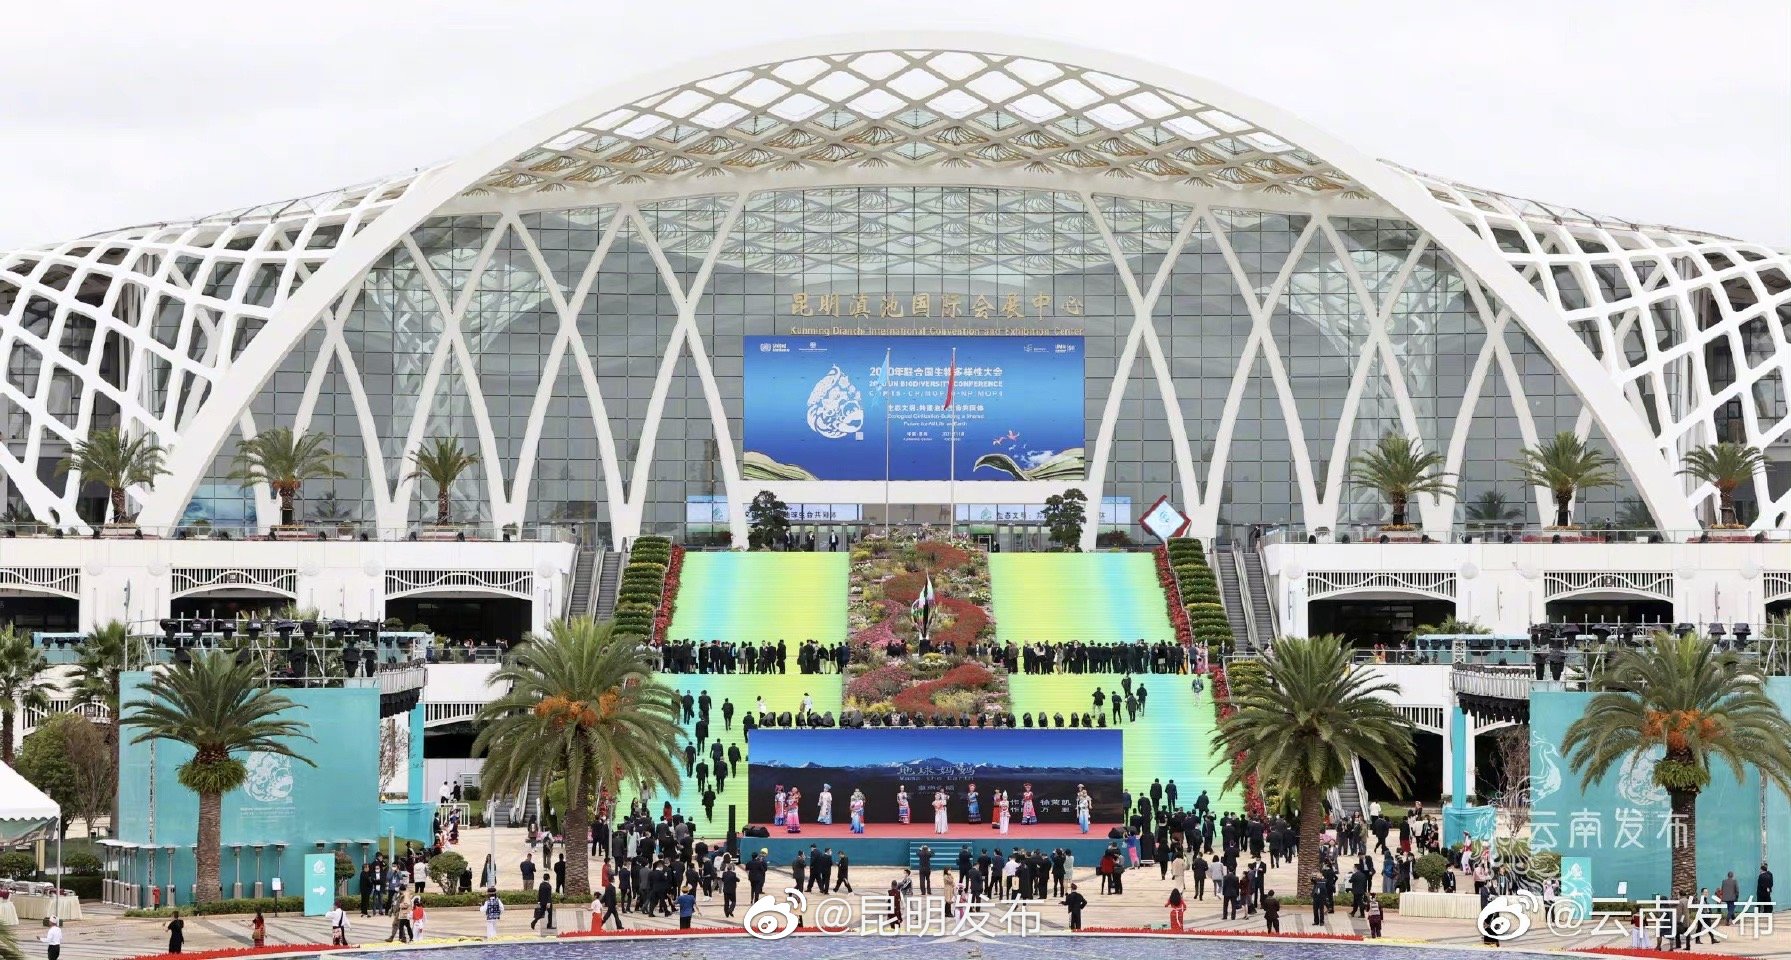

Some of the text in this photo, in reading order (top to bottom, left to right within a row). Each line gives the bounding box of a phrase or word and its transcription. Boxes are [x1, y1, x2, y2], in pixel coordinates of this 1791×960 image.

[791, 291, 1083, 320] 昆明滇池国际会展中心
[791, 327, 829, 336] Kunming
[869, 327, 926, 335] International
[929, 327, 980, 335] Convention
[1005, 327, 1049, 335] Exhibition
[1054, 327, 1083, 335] Center
[897, 766, 975, 776] 地球妈妈
